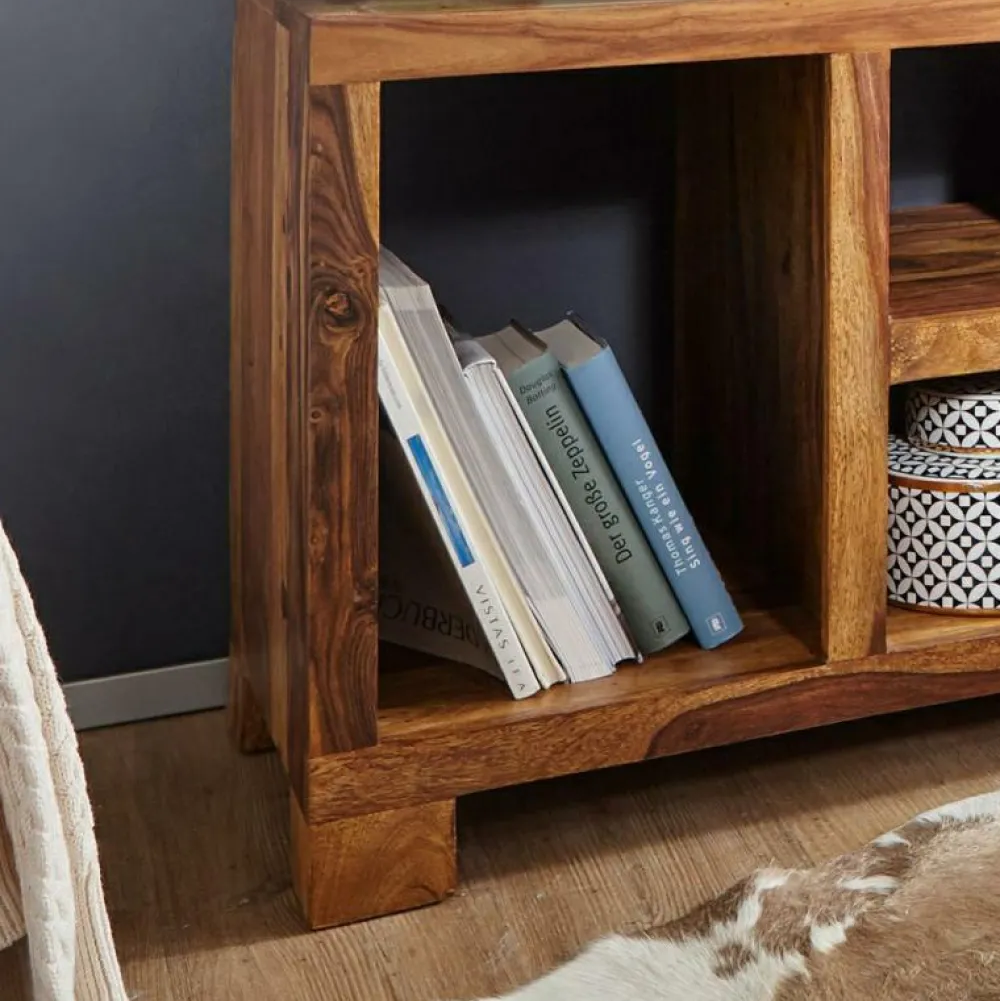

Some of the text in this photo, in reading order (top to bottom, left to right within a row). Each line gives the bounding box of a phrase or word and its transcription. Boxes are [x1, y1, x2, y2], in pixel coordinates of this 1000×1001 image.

[545, 405, 632, 564] Der große Zeppelin
[632, 438, 700, 569] Sing wie ein Vogel
[635, 479, 686, 576] Thomas Kanger
